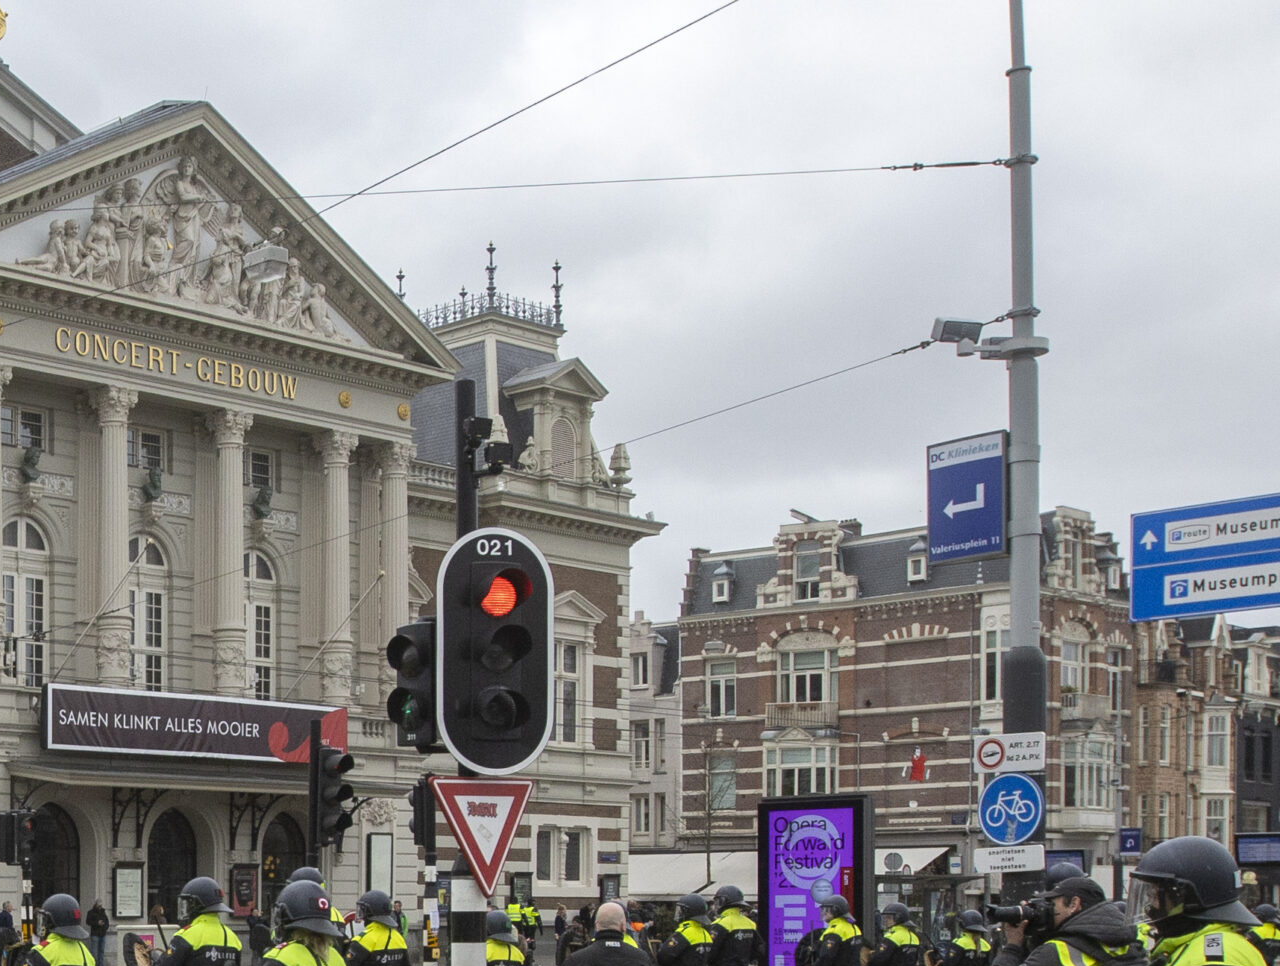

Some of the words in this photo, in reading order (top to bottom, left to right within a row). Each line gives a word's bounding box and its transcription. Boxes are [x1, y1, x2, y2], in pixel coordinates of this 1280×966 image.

[56, 326, 298, 400] CONCERT-GEBOUW
[930, 452, 945, 463] DC
[947, 442, 999, 460] Klinieken
[1183, 529, 1207, 538] route
[476, 539, 513, 556] 021
[931, 538, 987, 555] Valeriusplein
[991, 536, 1000, 545] 11
[1193, 573, 1278, 593] Museump
[59, 709, 108, 728] SAMEN
[114, 713, 161, 731] KLINKT
[165, 717, 202, 734] ALLES
[207, 720, 260, 738] MOOIER
[407, 733, 416, 741] 311
[774, 816, 827, 837] Opera
[775, 852, 838, 870] Festival
